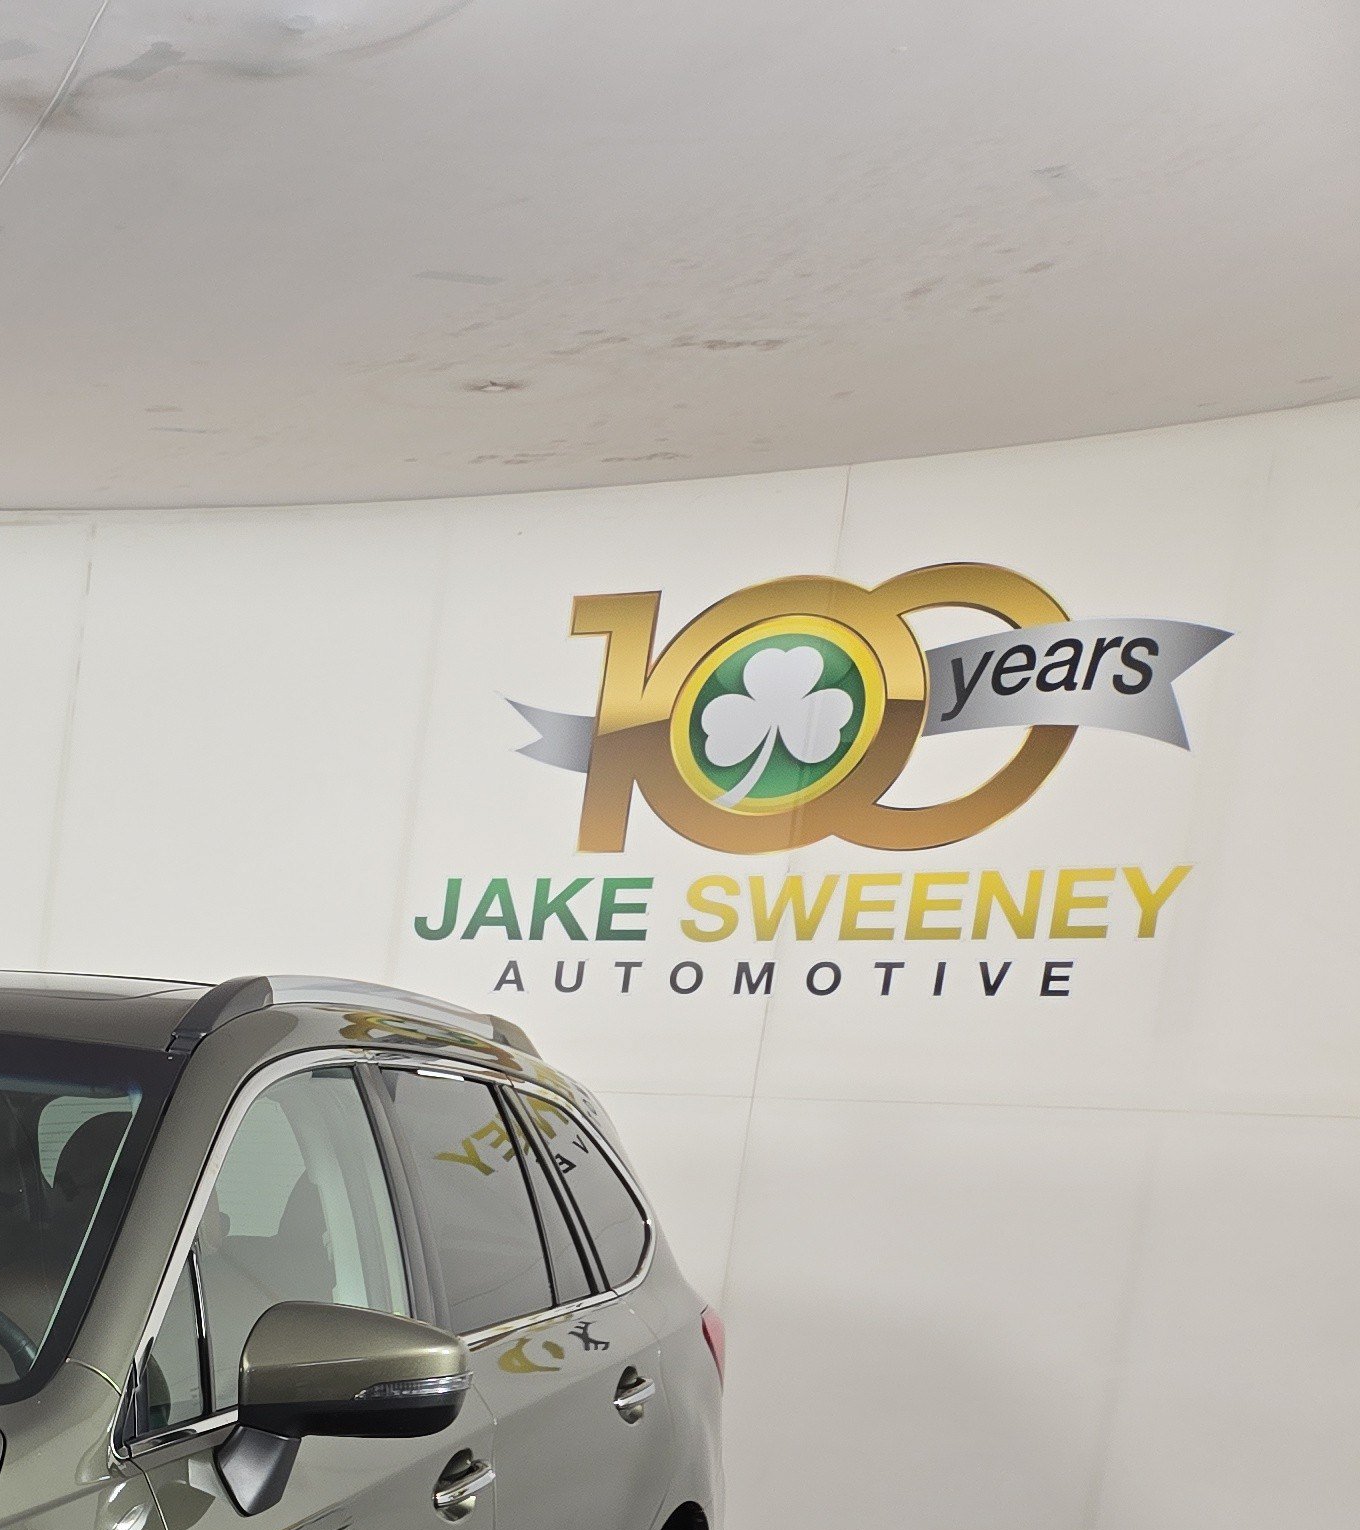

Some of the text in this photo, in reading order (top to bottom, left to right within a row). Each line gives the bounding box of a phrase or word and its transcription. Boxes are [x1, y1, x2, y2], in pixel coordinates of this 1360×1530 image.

[567, 561, 1160, 856] 100 years
[413, 863, 1194, 943] JAKE SWEENEY
[492, 960, 1076, 998] AUTOMOTIVE
